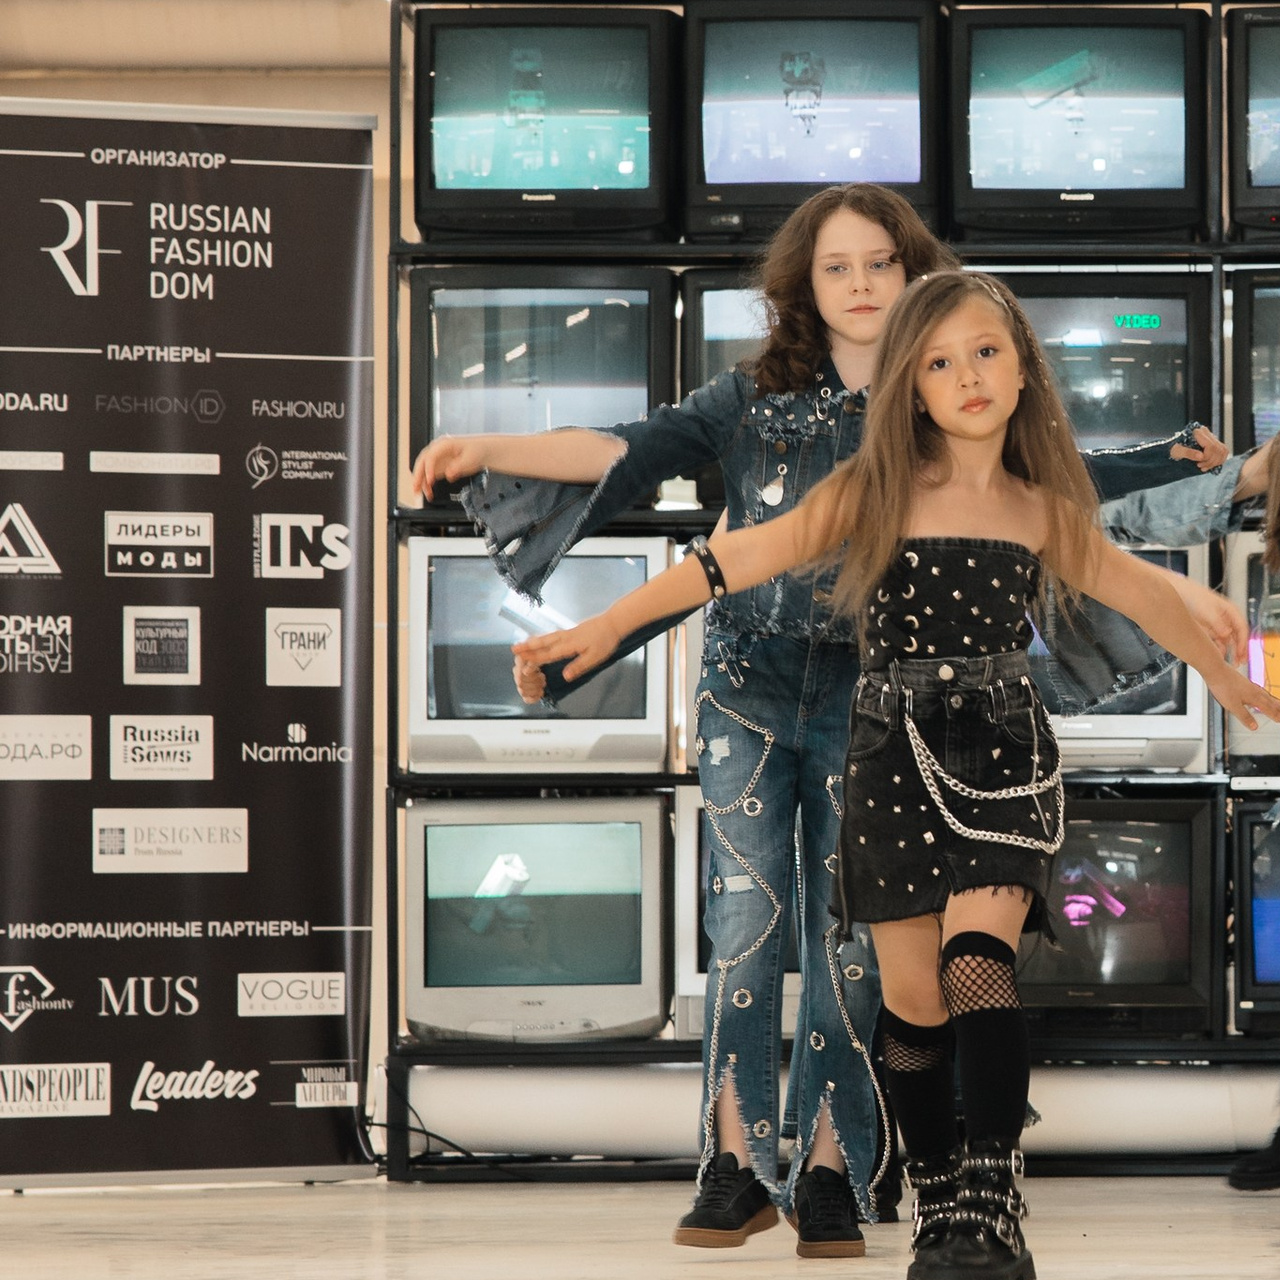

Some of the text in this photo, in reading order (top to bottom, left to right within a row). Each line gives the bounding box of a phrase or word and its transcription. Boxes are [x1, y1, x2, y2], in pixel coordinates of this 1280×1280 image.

[90, 148, 226, 169] ОРГАНИЗАТОР
[150, 202, 271, 234] RUSSIAN
[150, 237, 273, 269] FASHION
[150, 271, 214, 300] DOM
[1114, 314, 1161, 328] VIDEO
[107, 344, 210, 363] ПАРТНЕРЫ
[0, 392, 68, 412] DA.RU
[94, 394, 189, 414] FASHION
[252, 399, 345, 420] FASHION.RU
[282, 451, 348, 460] INTERNATIONAL
[282, 461, 314, 470] STYLIST
[282, 470, 334, 480] COMMUNITY
[117, 524, 201, 538] ЛИДЕРЫ
[117, 551, 202, 569] МОДЫ
[281, 631, 327, 650] ГРАНИ
[123, 725, 199, 742] Russia
[0, 742, 83, 762] ОДА.РФ
[131, 745, 192, 763] Sews
[242, 741, 353, 763] Narmania
[134, 826, 242, 844] DESIGNERS
[8, 920, 309, 941] ИНФОРМАЦИОННЫЕ ПАРТНЕРЫ
[98, 976, 199, 1017] MUS
[242, 979, 340, 1001] VOGUE
[130, 1060, 260, 1112] Leaders
